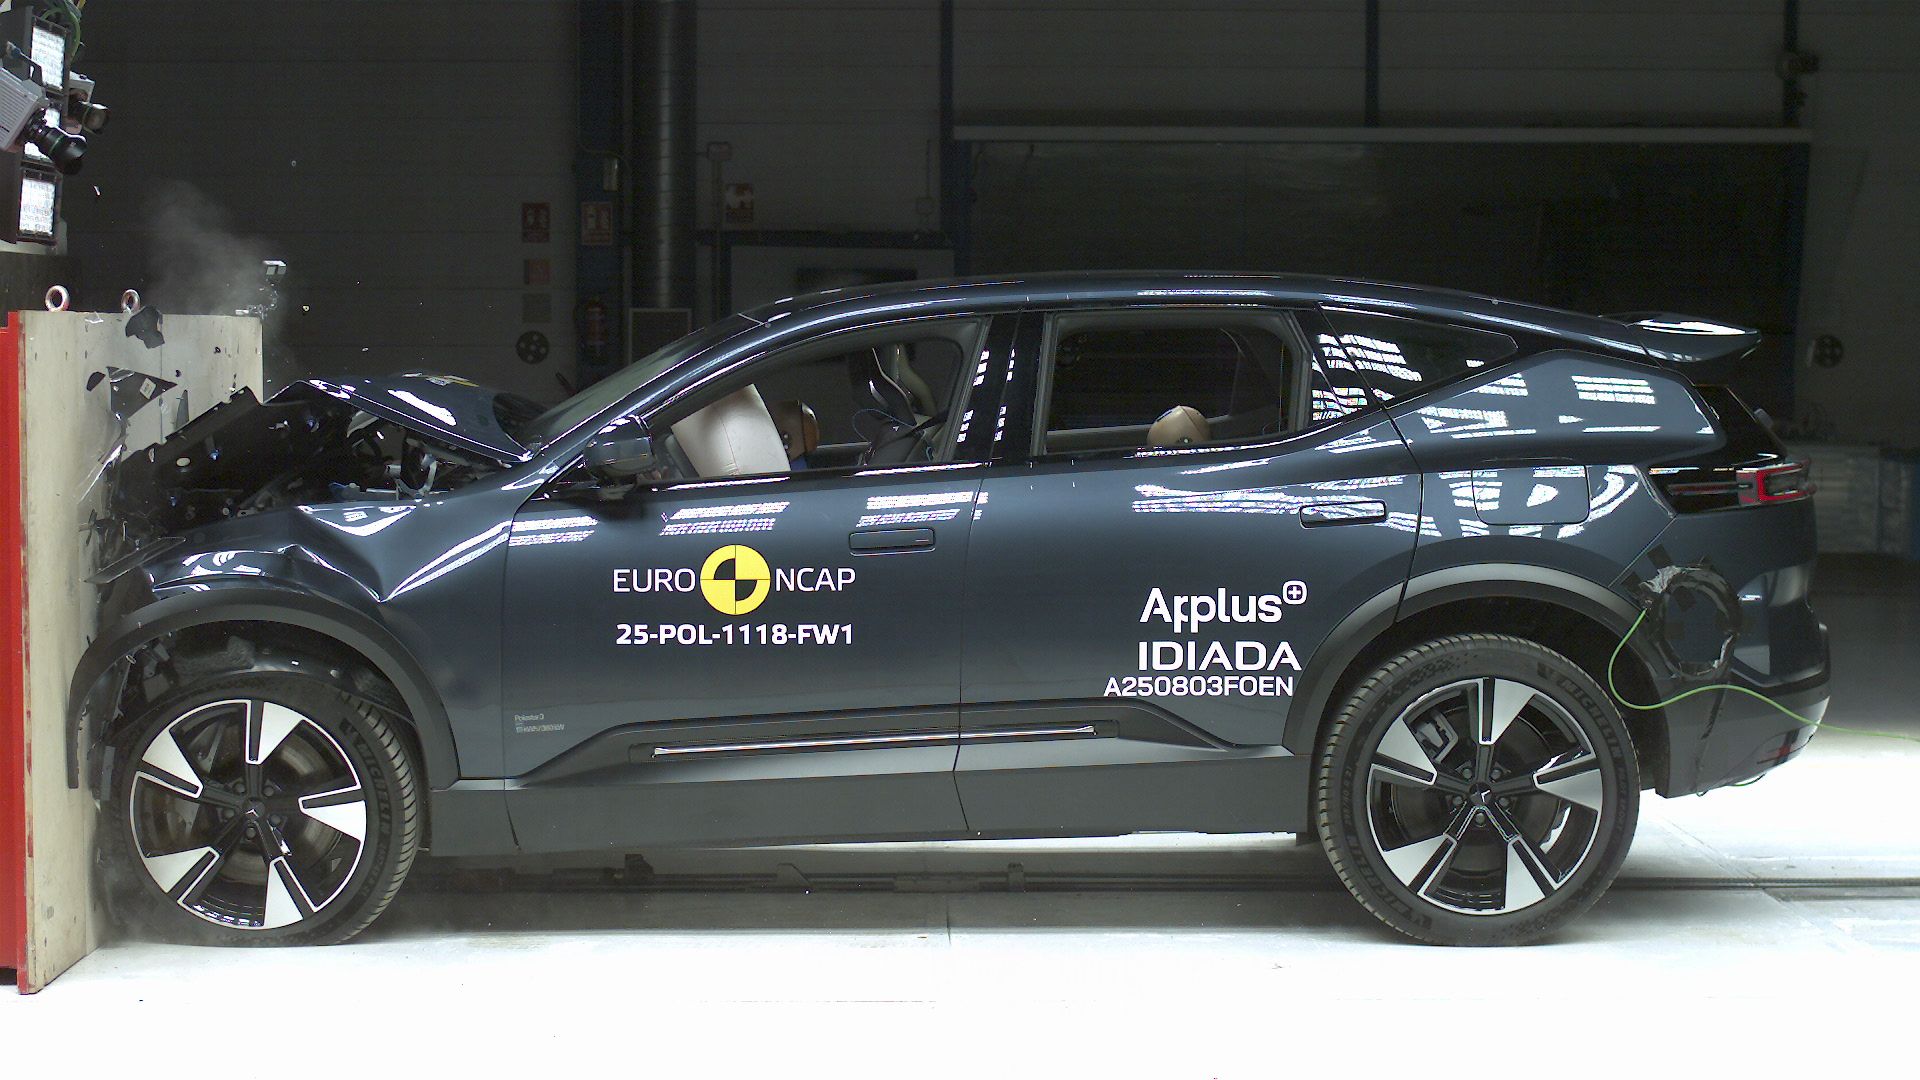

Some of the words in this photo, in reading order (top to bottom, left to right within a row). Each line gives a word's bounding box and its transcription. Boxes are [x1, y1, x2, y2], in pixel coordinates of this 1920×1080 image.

[614, 569, 695, 592] EURO
[776, 568, 855, 591] NCAP
[617, 624, 851, 644] 25-POL-1118-FW1
[1139, 641, 1302, 670] IDIADA
[1559, 677, 1623, 759] MICHELIN
[355, 739, 391, 834] MICHELIN
